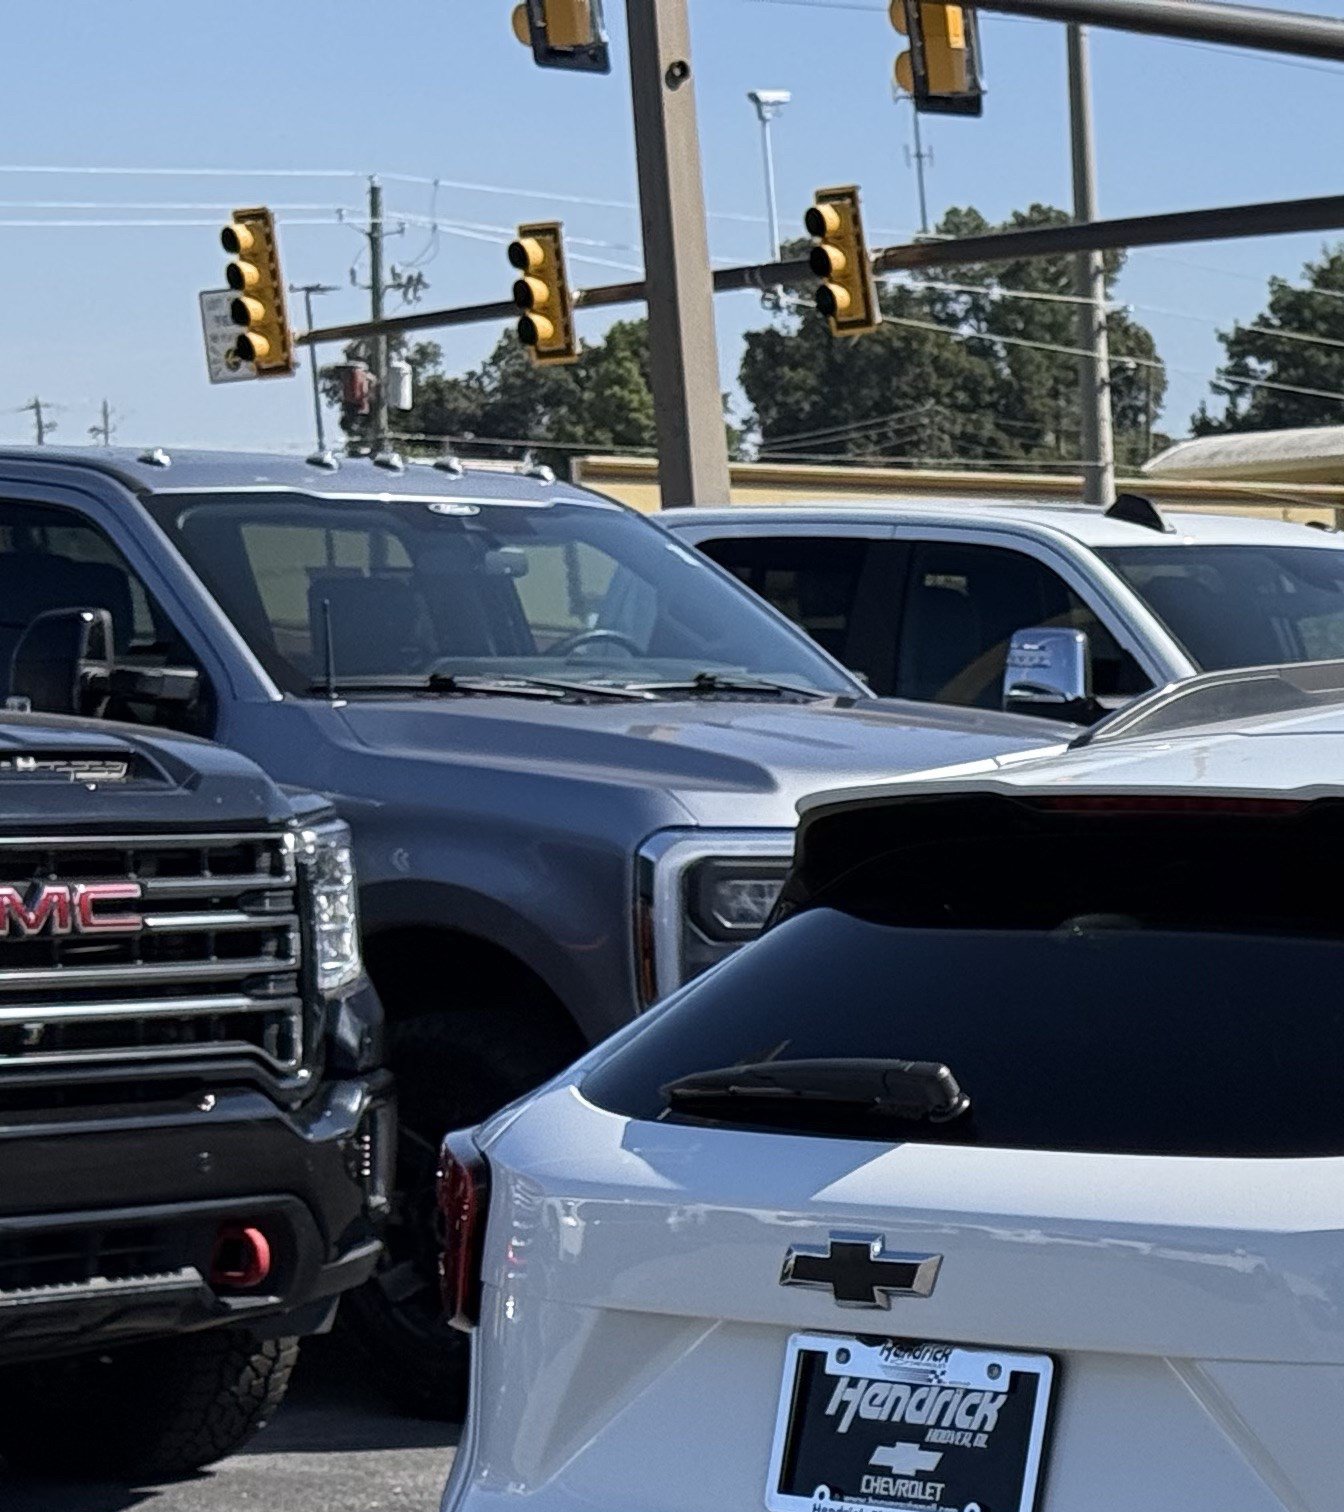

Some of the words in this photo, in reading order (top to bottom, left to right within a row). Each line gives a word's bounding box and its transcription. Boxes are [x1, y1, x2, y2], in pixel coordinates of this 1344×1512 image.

[0, 882, 142, 936] MC
[825, 1376, 1008, 1433] Hendrick
[860, 1474, 945, 1502] CHEVROLET
